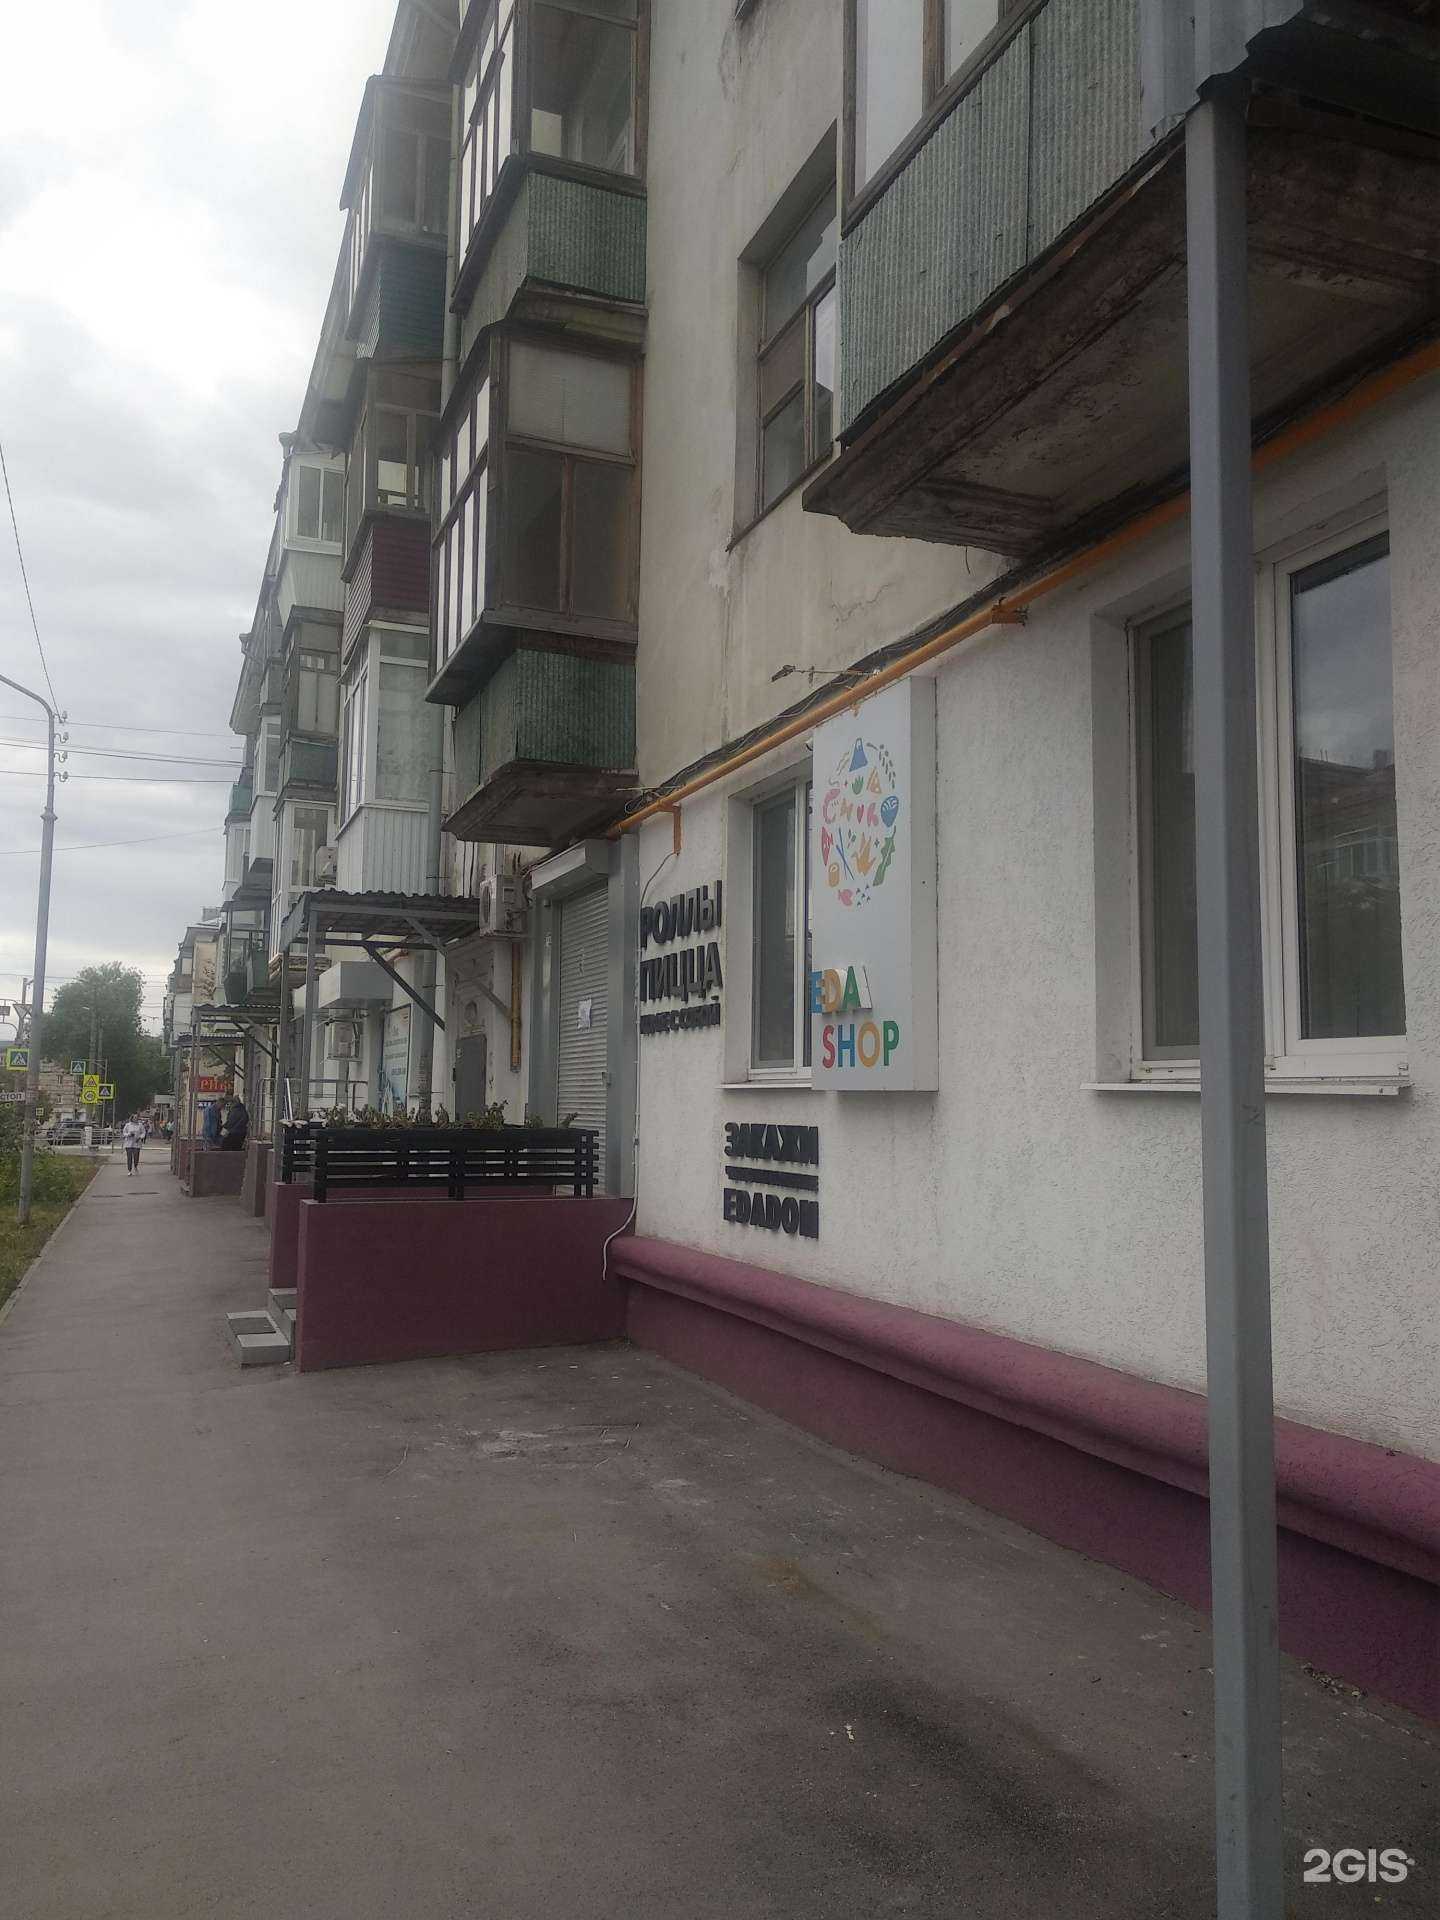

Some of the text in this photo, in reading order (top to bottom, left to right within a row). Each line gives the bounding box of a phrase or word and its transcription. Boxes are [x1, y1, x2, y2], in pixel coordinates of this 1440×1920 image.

[640, 880, 722, 948] РОЛЛЫ
[640, 942, 723, 1004] ПИЦЦА
[809, 965, 872, 1014] EDA
[822, 1020, 900, 1069] SHOP
